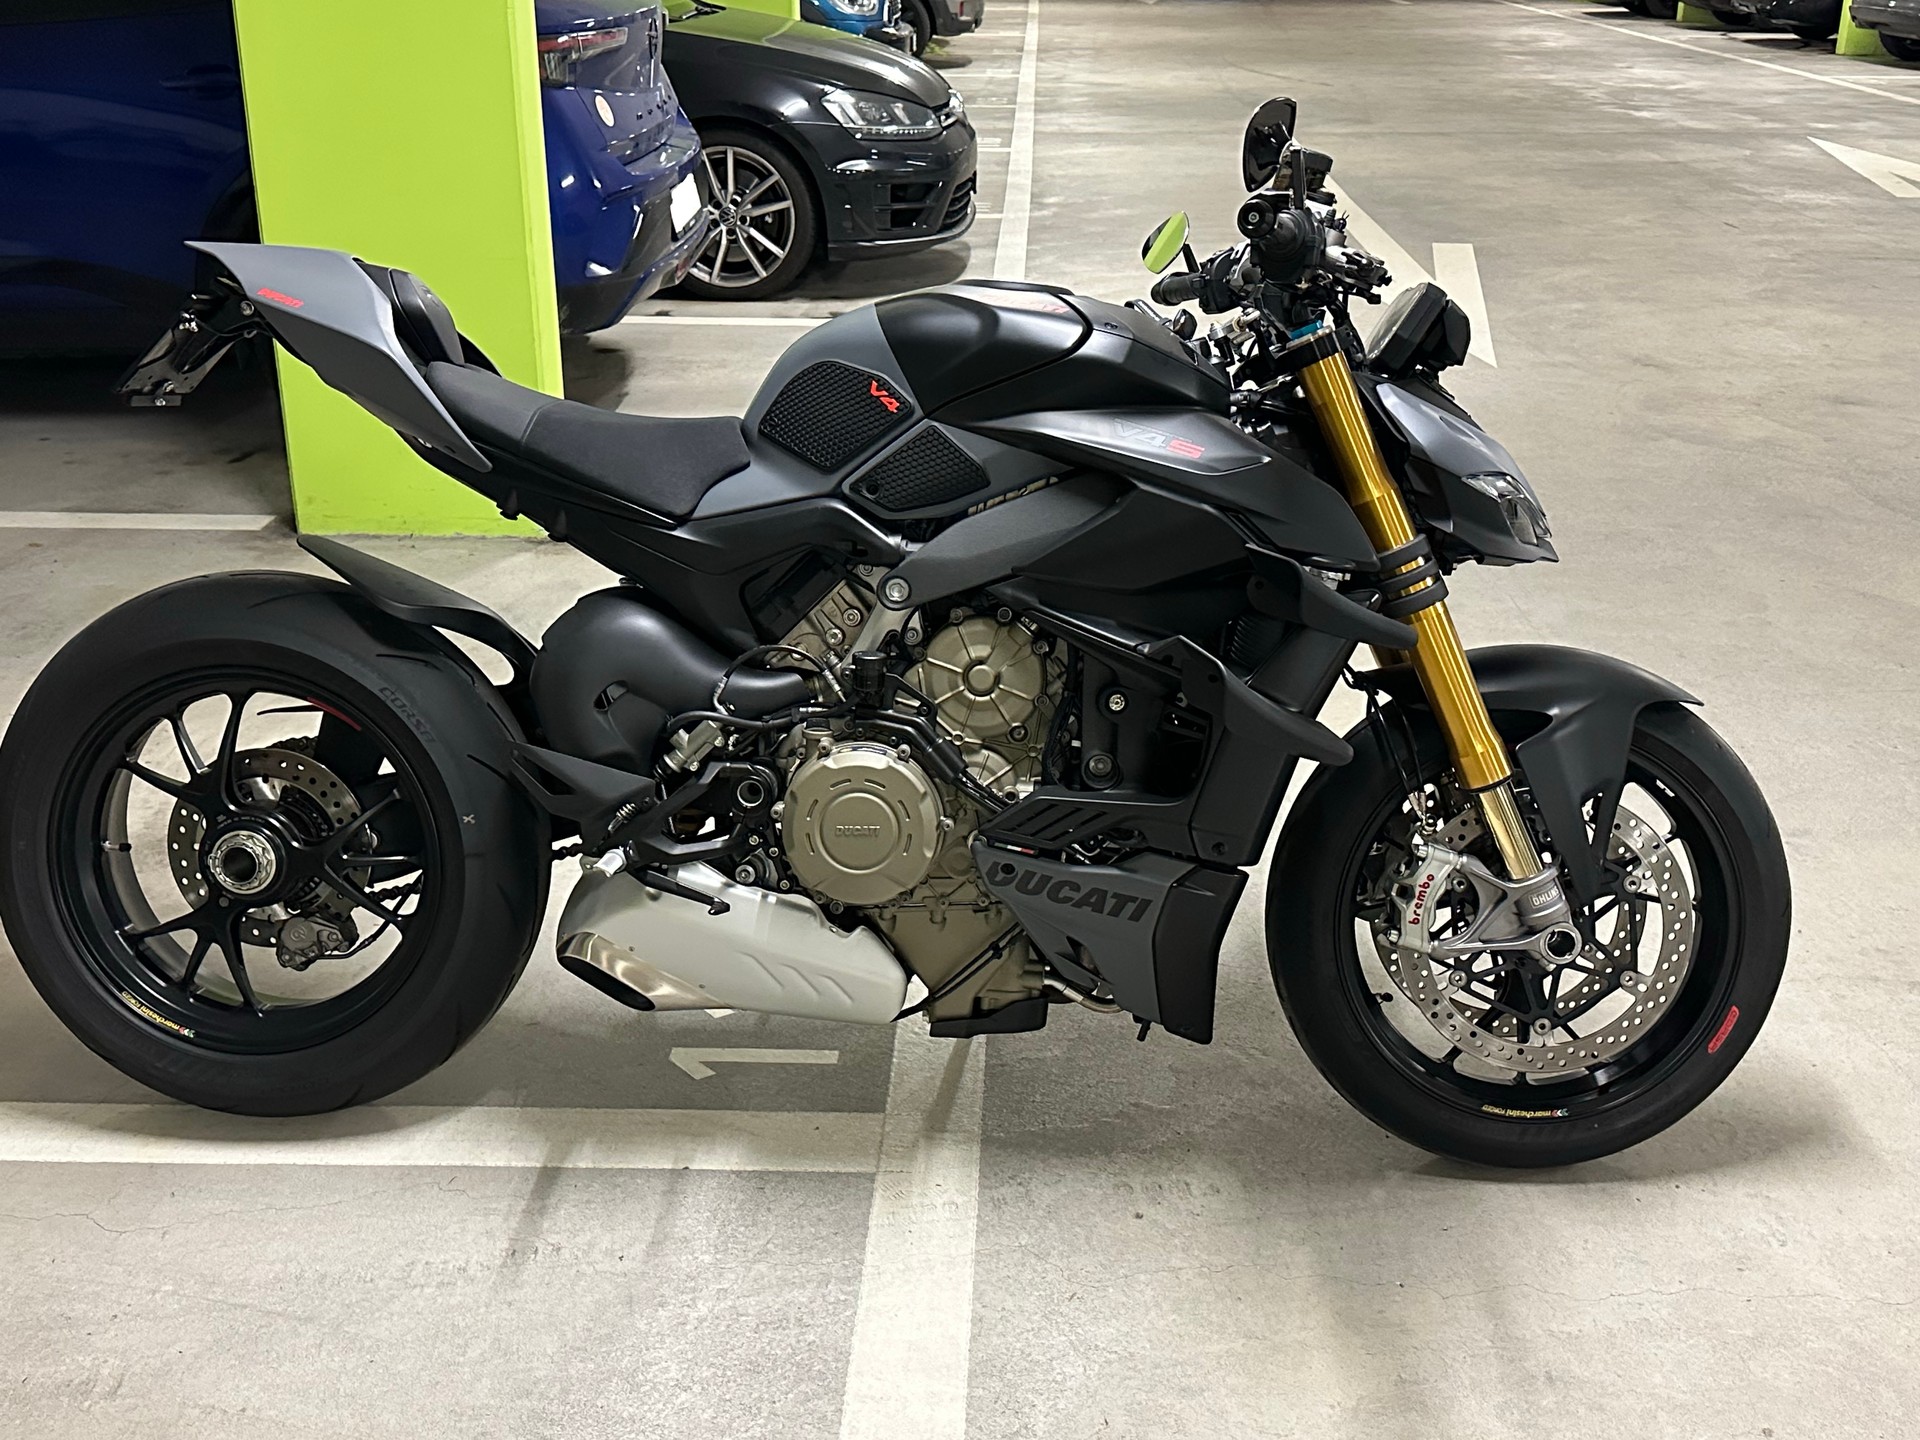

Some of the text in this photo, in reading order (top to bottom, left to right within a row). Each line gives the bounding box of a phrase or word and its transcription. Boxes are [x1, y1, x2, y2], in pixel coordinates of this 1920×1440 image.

[870, 379, 900, 413] V4
[835, 825, 880, 837] DUCATI
[985, 860, 1153, 923] DUCATI
[1408, 873, 1435, 926] brembo
[140, 1005, 180, 1030] marchesini
[1506, 1108, 1551, 1119] marchesini
